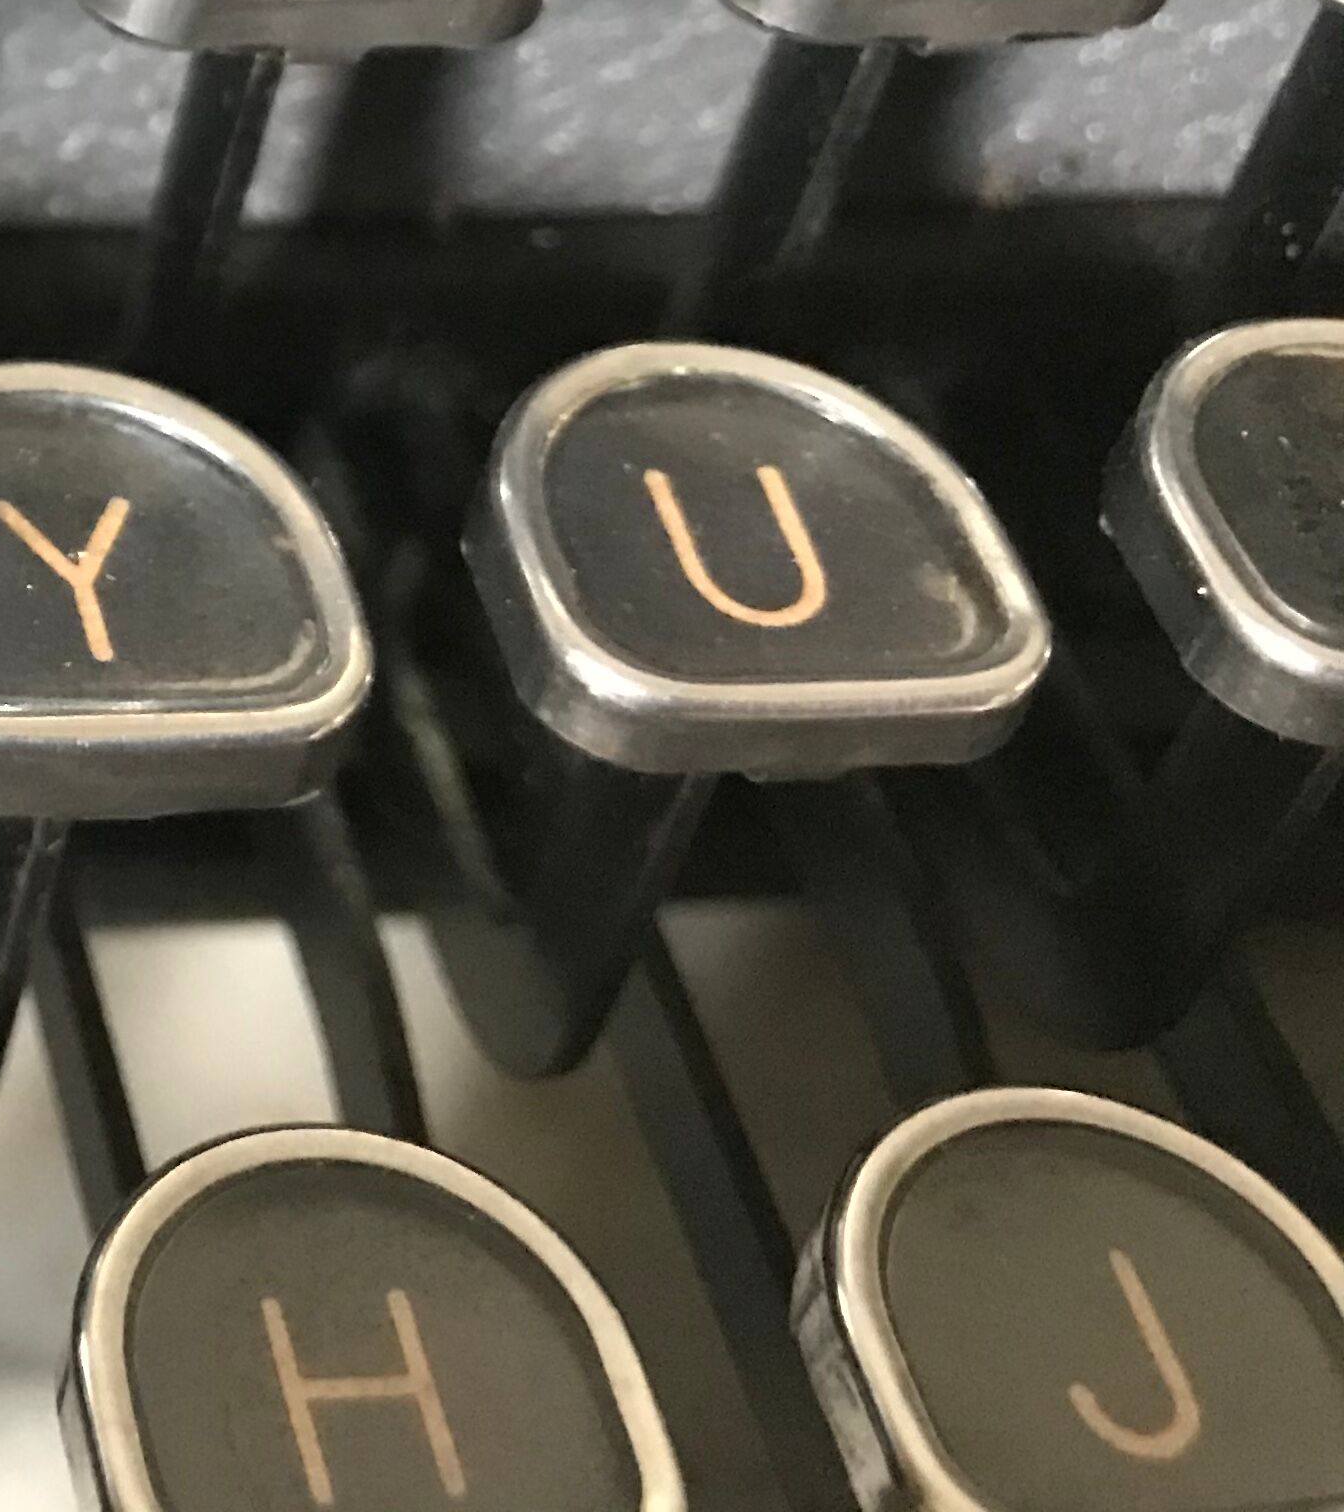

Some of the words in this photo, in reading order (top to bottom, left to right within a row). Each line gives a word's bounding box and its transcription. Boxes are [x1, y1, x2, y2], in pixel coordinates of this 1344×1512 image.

[643, 463, 829, 628] U
[260, 1288, 466, 1508] H
[1066, 1248, 1207, 1465] J
